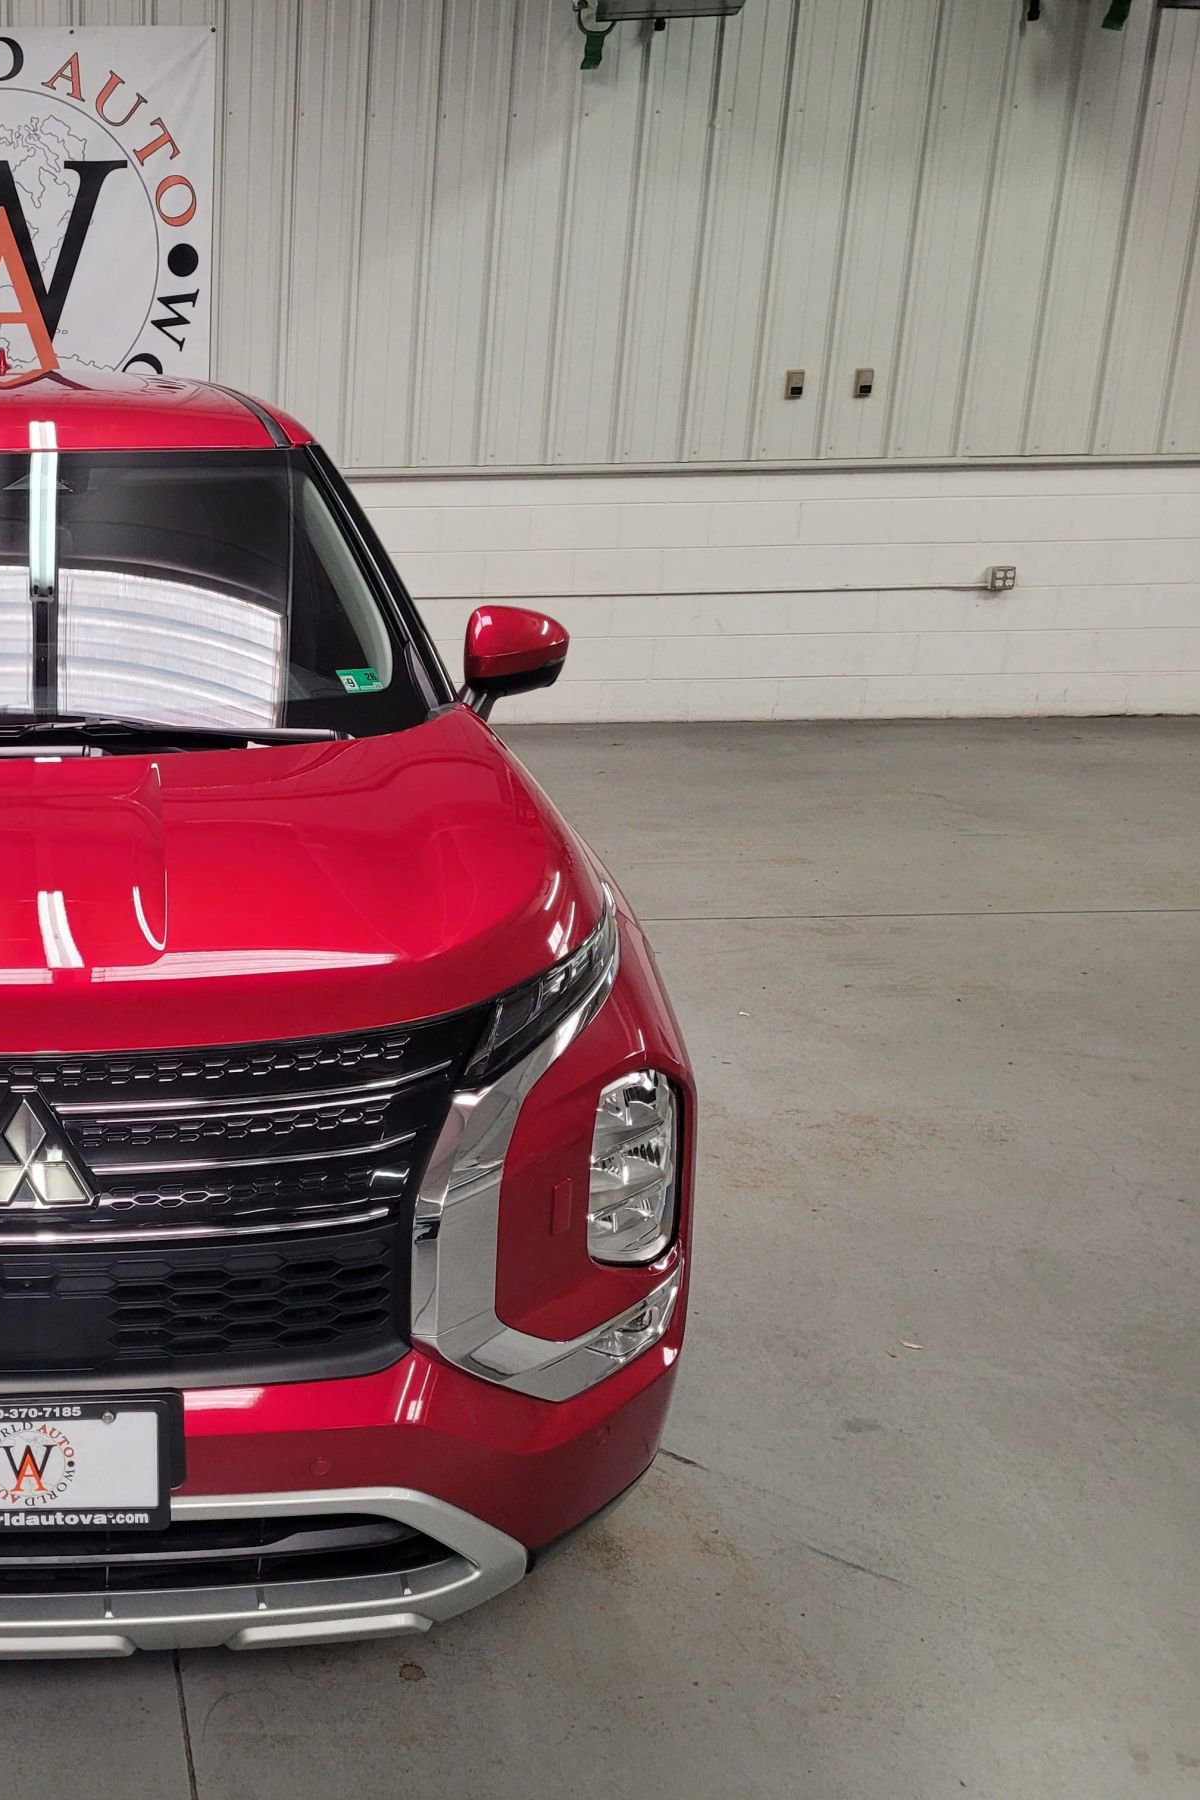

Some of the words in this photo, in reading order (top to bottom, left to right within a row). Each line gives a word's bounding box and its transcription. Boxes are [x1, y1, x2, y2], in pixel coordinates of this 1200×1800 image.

[42, 52, 197, 228] AUTO
[37, 1424, 75, 1457] AUTO
[24, 1469, 75, 1506] WORLD
